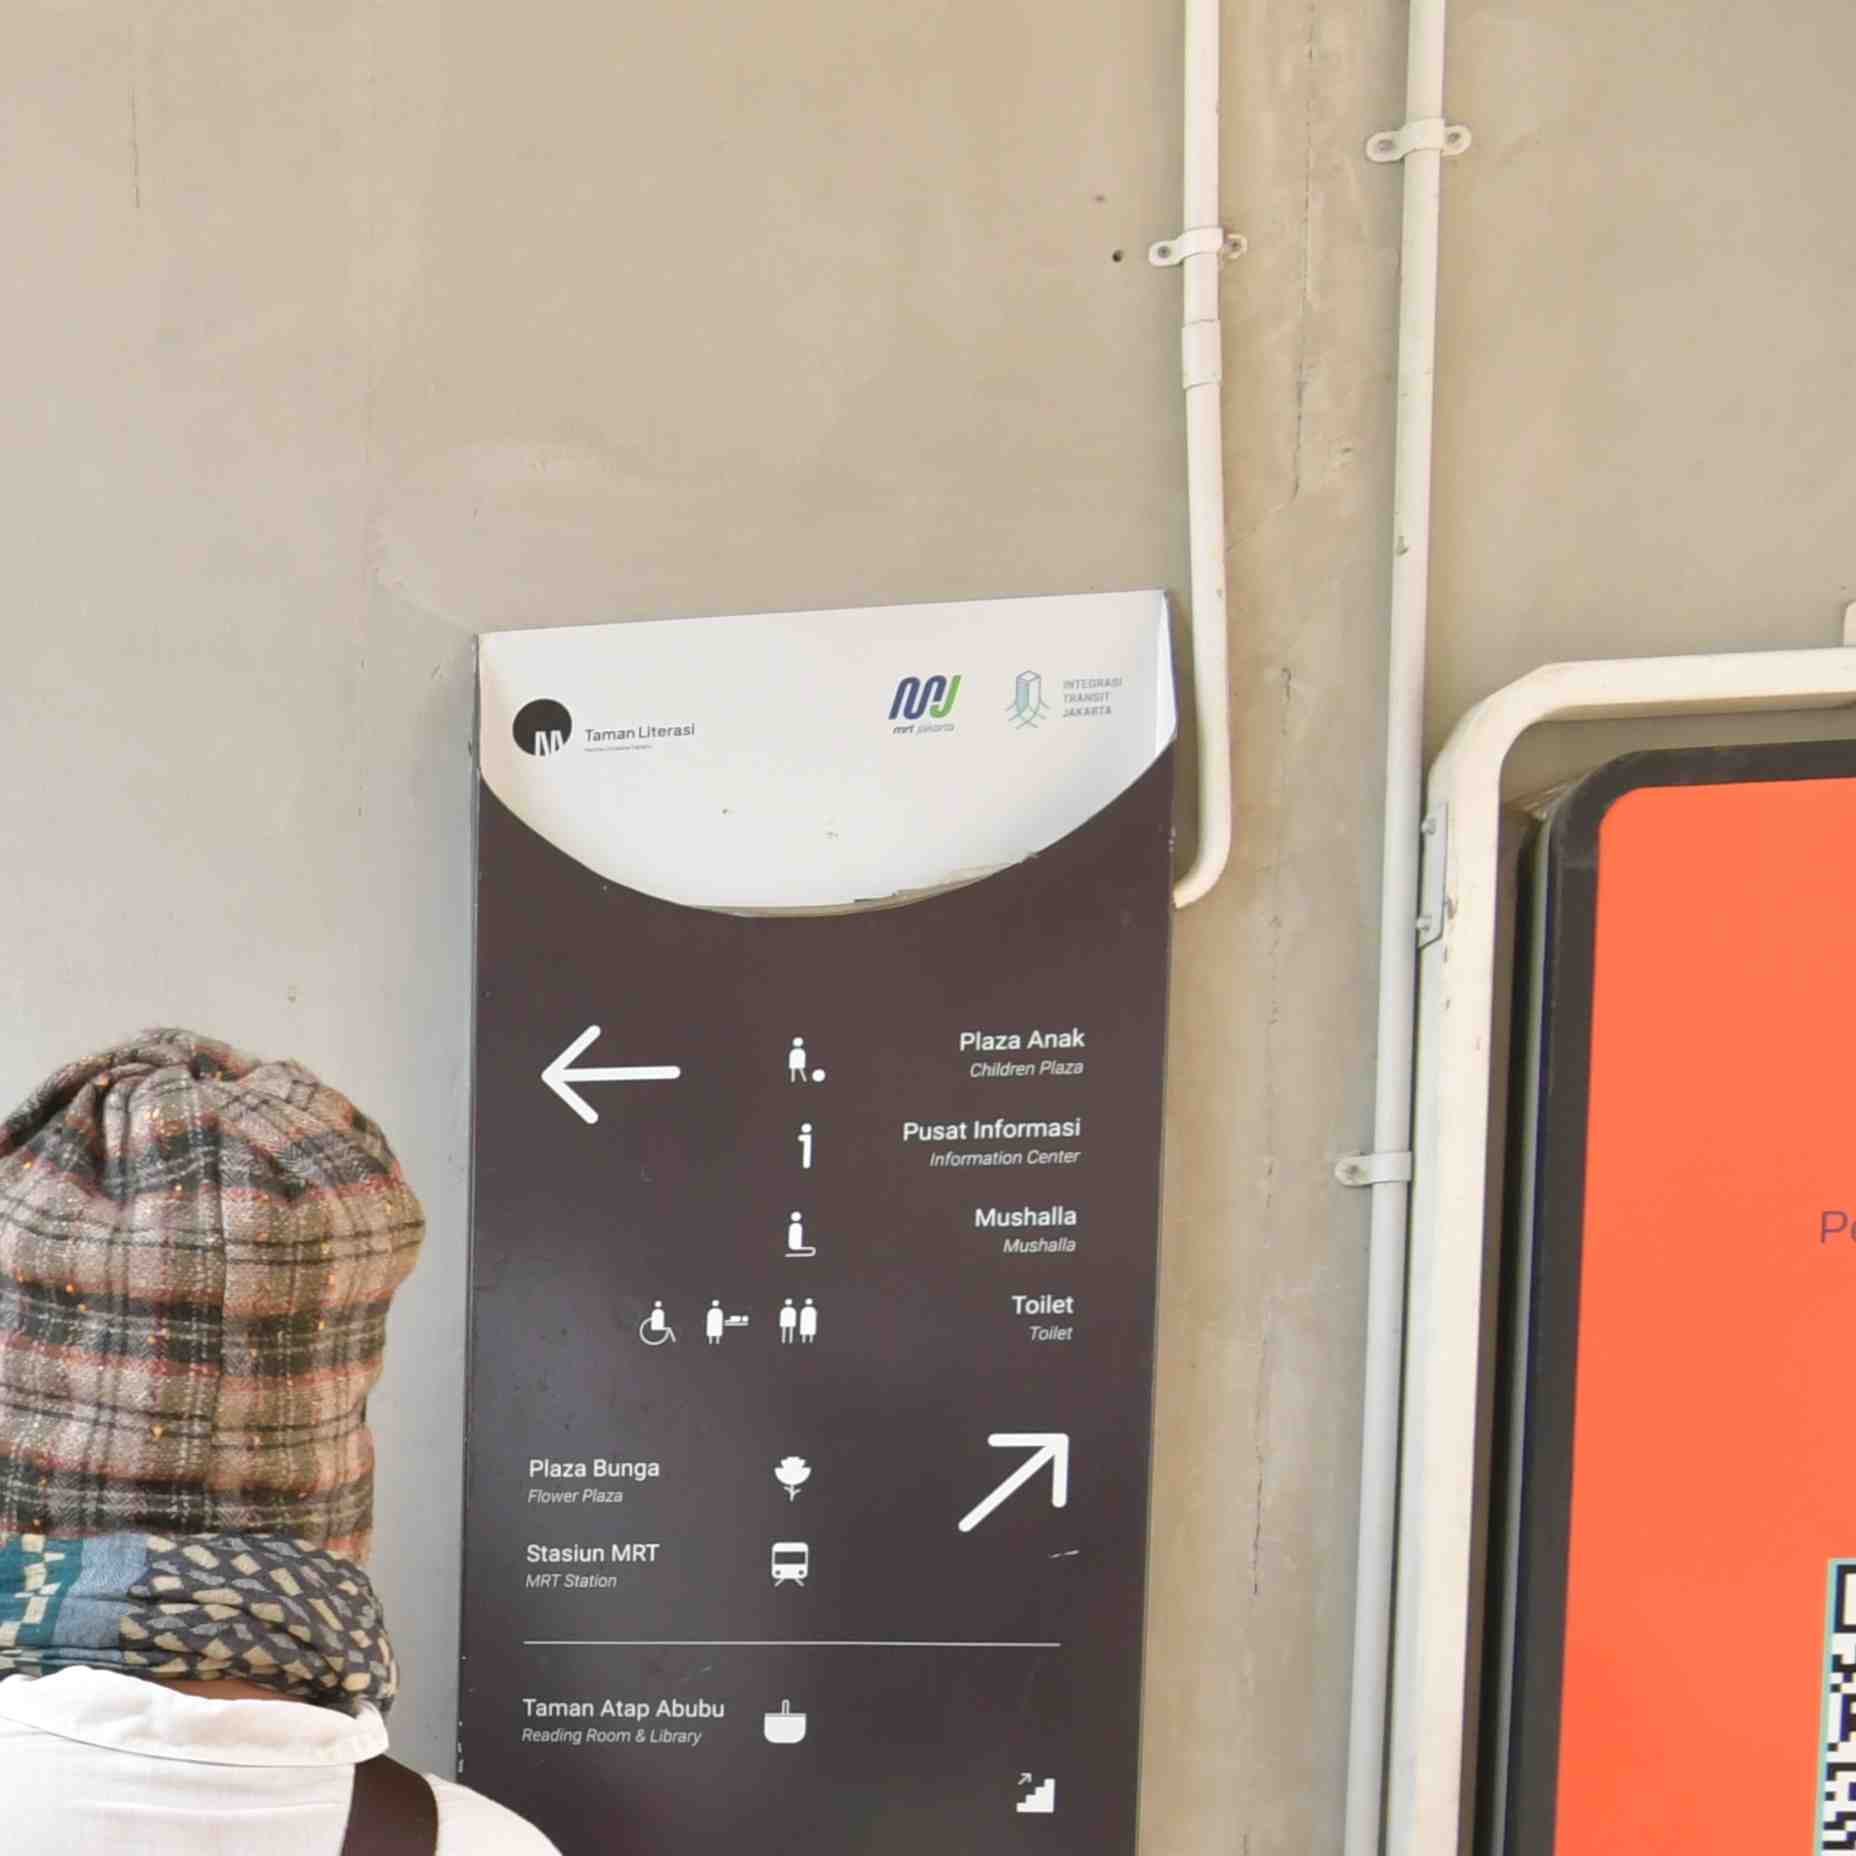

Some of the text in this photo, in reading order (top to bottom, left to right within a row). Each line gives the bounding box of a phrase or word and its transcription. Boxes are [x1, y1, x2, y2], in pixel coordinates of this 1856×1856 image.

[1063, 677, 1123, 690] INTEGRASI
[1063, 691, 1110, 704] TRANSIT
[1063, 705, 1112, 718] JAKARTA
[584, 723, 696, 743] Taman Literasi
[892, 723, 914, 736] mrt
[959, 1027, 1086, 1052] Plaza Anak
[970, 1059, 1085, 1079] Children Plaza
[902, 1117, 1082, 1142] Pusat Informasi
[929, 1149, 1082, 1168] Information Center
[974, 1205, 1078, 1229] Mushalla
[1002, 1236, 1077, 1255] Mushalla
[1011, 1294, 1075, 1317] Toilet
[1029, 1324, 1073, 1342] Toilet
[528, 1458, 661, 1484] Plaza Bunga
[527, 1487, 624, 1504] Flower Plaza
[526, 1542, 660, 1564] Stasiun MRT
[525, 1573, 618, 1590] MRT Station
[522, 1698, 725, 1723] Taman Atap Abubu
[521, 1727, 702, 1748] Reading Room & Library
